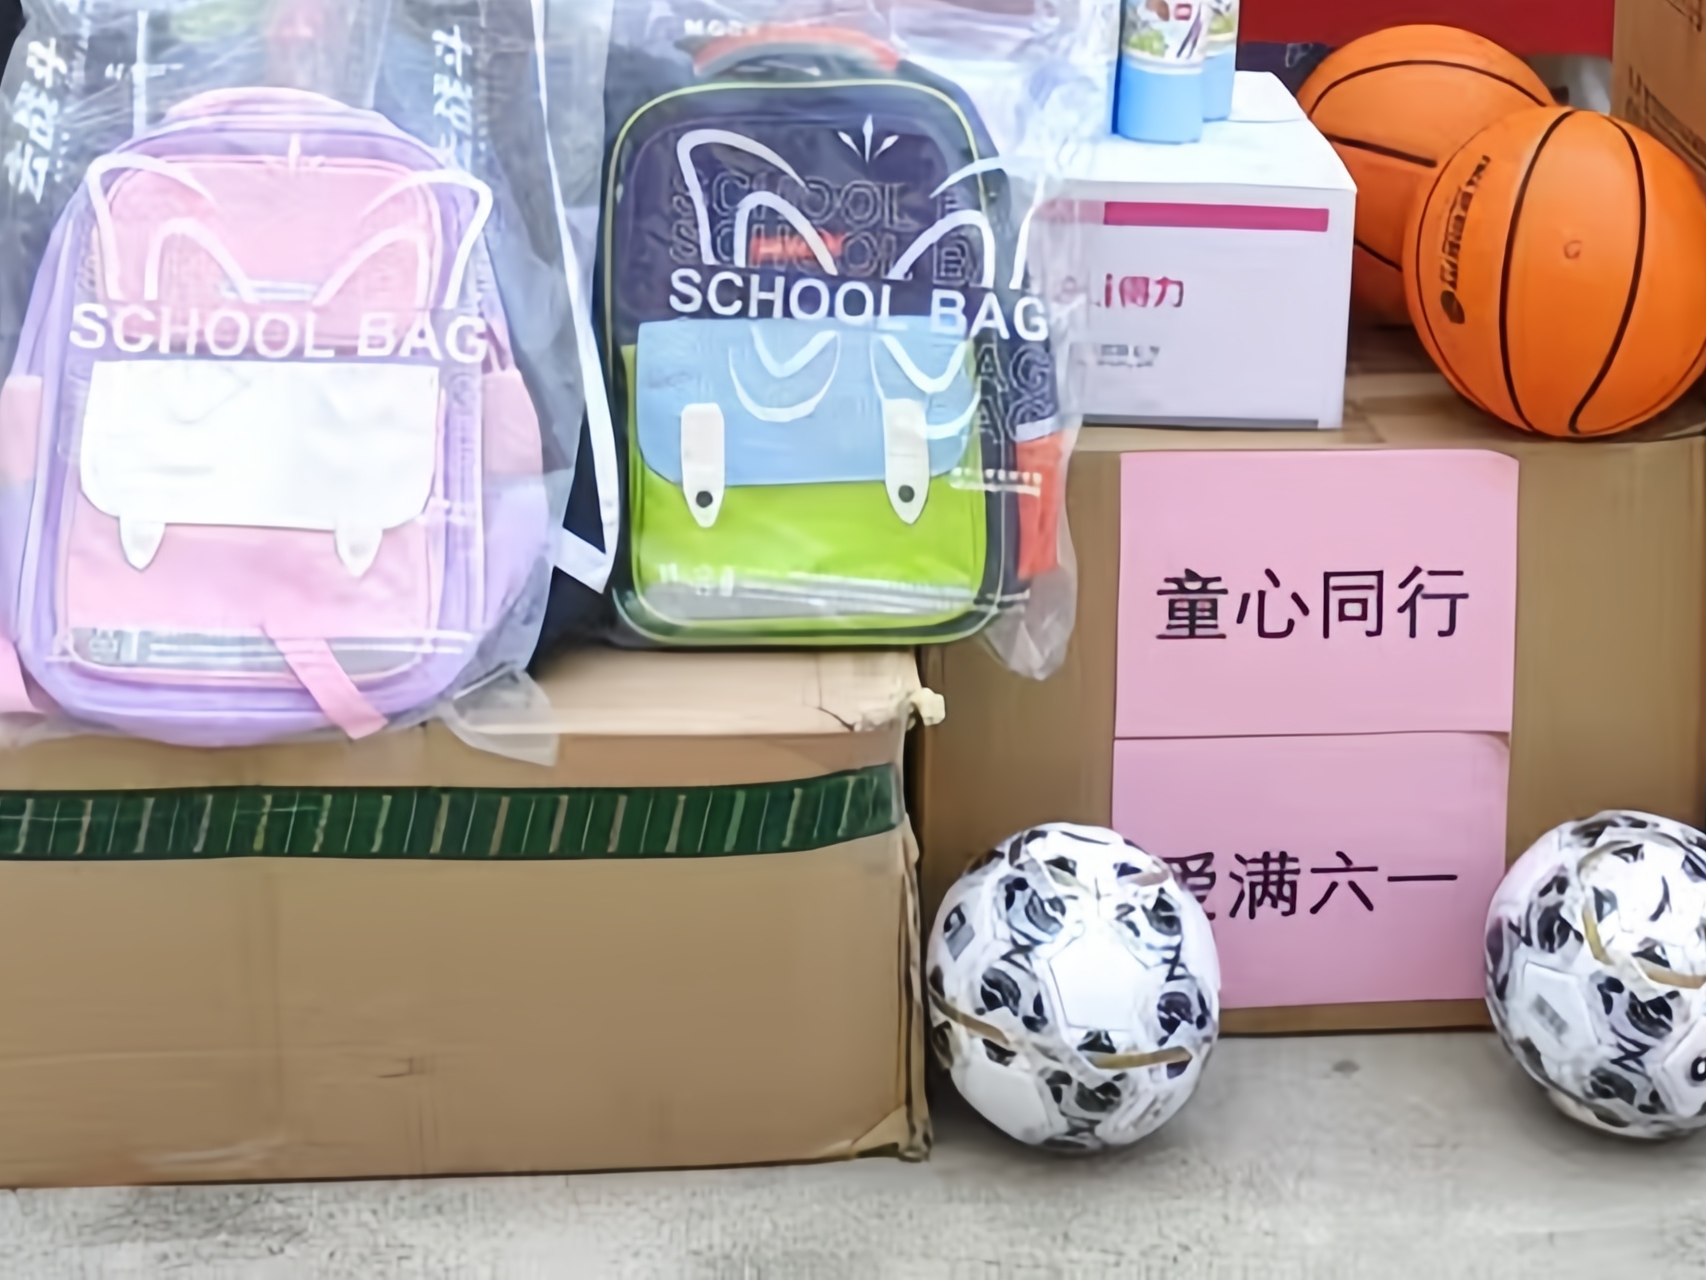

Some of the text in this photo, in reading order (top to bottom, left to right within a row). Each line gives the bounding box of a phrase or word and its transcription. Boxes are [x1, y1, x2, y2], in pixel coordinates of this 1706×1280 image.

[69, 302, 490, 364] SCHOOL BAG
[668, 267, 1051, 342] SCHOOL BAG
[1154, 564, 1471, 641] 童心同行
